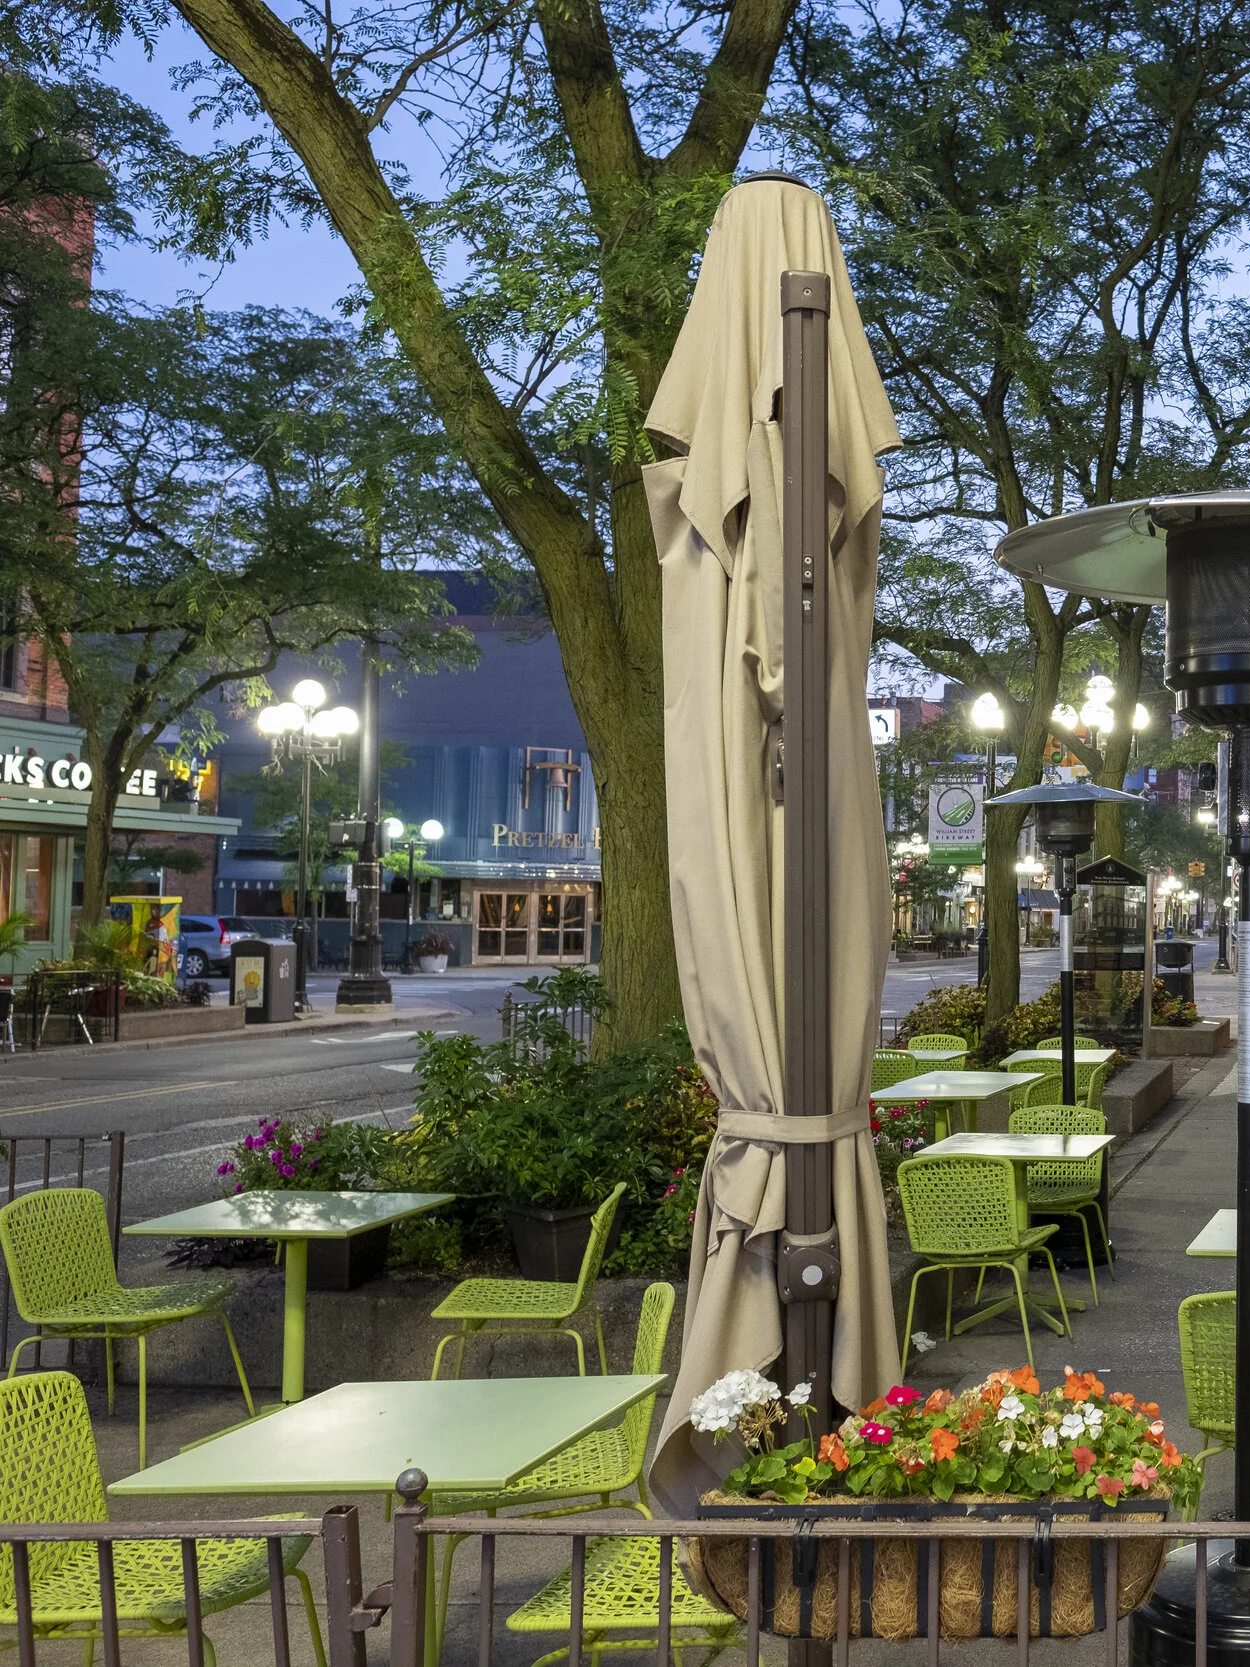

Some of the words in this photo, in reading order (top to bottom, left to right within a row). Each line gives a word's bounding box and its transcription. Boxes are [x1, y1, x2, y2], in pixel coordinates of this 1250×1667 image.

[0, 754, 44, 786] KS
[51, 759, 158, 796] COEE
[491, 823, 585, 849] PRETZEL
